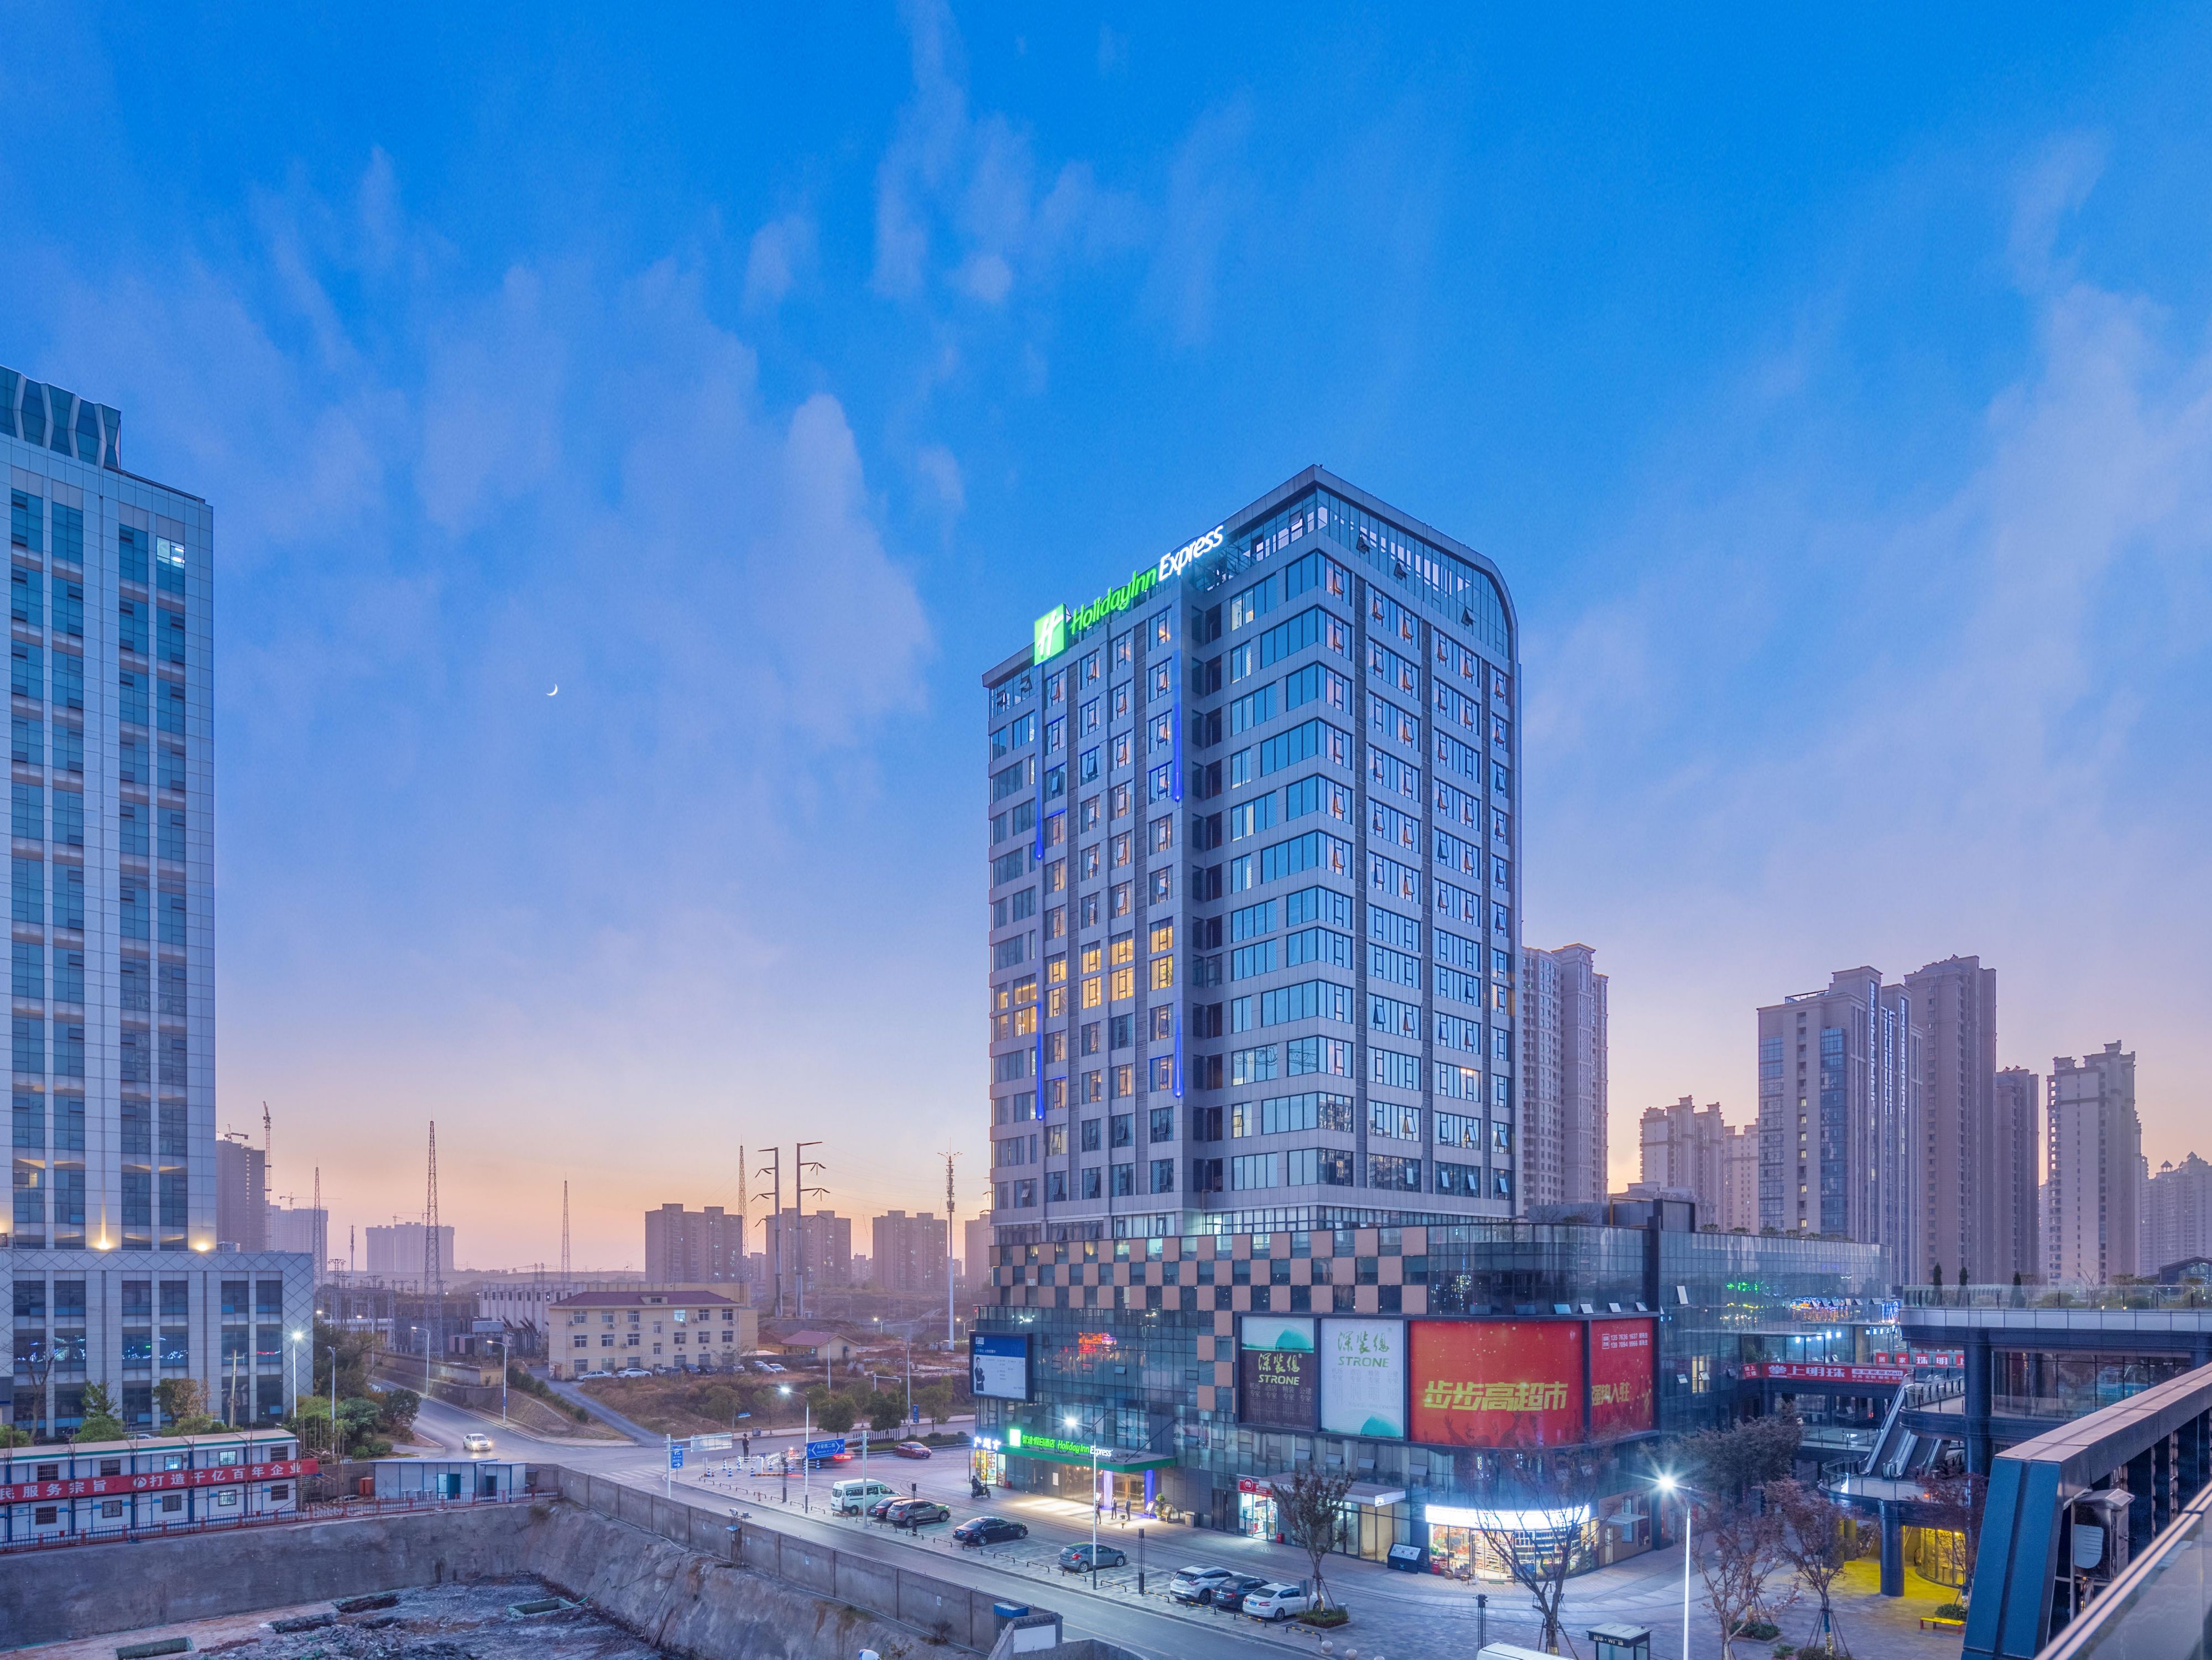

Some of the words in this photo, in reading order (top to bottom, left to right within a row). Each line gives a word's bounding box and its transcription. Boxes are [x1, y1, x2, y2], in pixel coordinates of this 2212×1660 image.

[1159, 525, 1224, 581] Express
[1338, 1356, 1389, 1367] STRONE
[1768, 1365, 1845, 1377] 掌上明珠
[1259, 1375, 1300, 1385] STRONE
[1424, 1380, 1568, 1411] 步步高超市
[1022, 1435, 1056, 1448] 智选假日酒店
[149, 1463, 302, 1487] 打造千亿百年企业
[0, 1480, 107, 1500] 民服务宗旨
